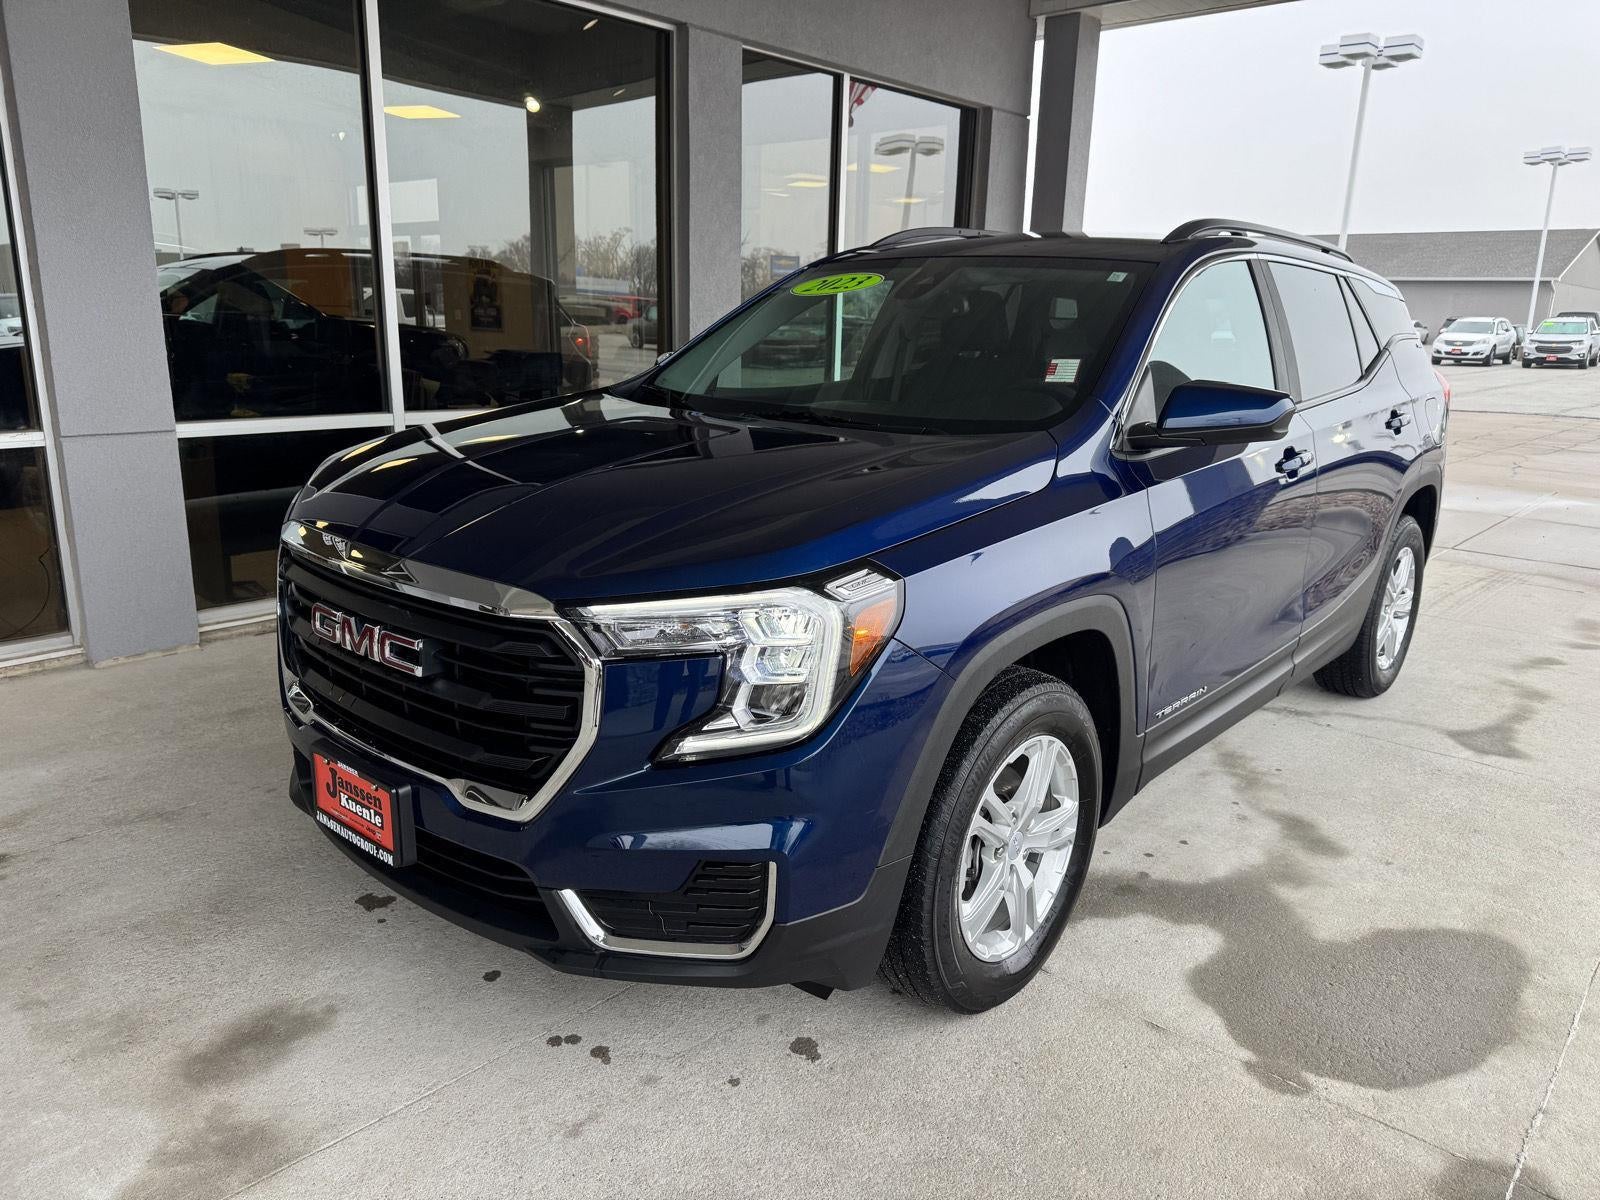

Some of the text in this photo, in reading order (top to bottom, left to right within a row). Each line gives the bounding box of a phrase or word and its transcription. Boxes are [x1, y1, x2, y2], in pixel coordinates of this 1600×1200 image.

[801, 275, 873, 293] 2023
[311, 602, 423, 678] GMC
[1155, 685, 1208, 719] TERRAIN
[325, 766, 383, 811] Janssen
[339, 791, 383, 828] Kuenle
